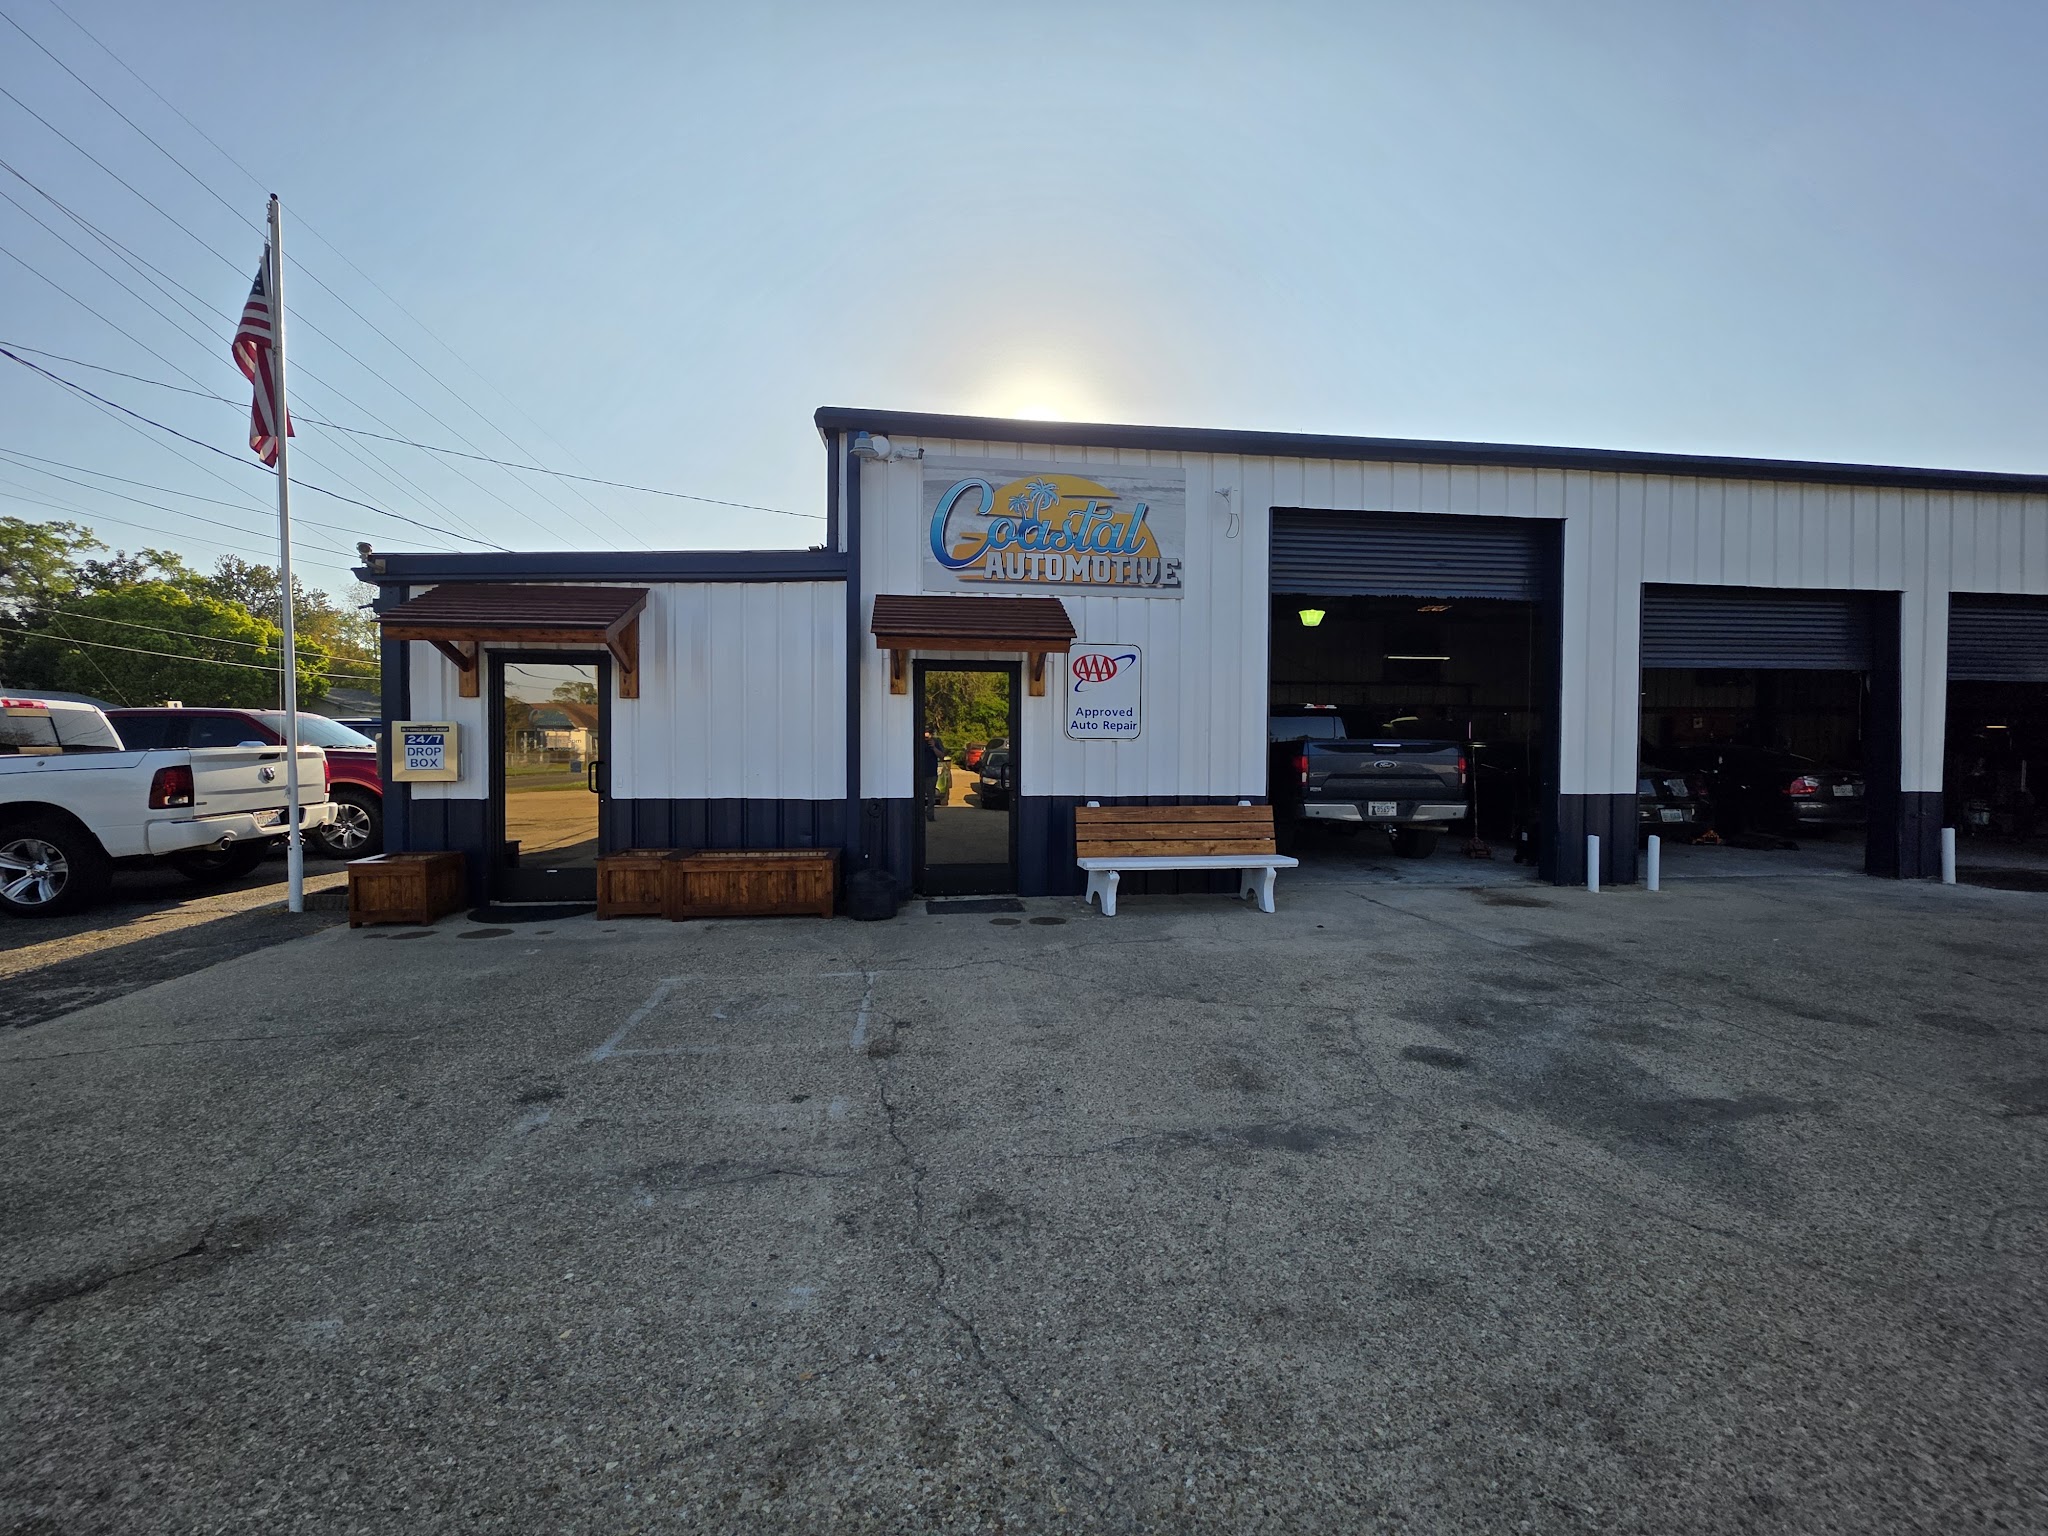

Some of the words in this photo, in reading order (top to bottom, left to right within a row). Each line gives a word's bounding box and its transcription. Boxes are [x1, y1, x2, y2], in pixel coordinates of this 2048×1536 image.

[930, 477, 1147, 570] Coastal
[983, 551, 1181, 587] AUTOMOTIVE
[1077, 654, 1114, 682] AAA
[1075, 707, 1133, 718] Approved
[1070, 720, 1098, 730] Auto
[1103, 720, 1137, 732] Repair
[407, 735, 441, 744] 24/7
[407, 747, 441, 756] DROP
[410, 758, 438, 767] BOX
